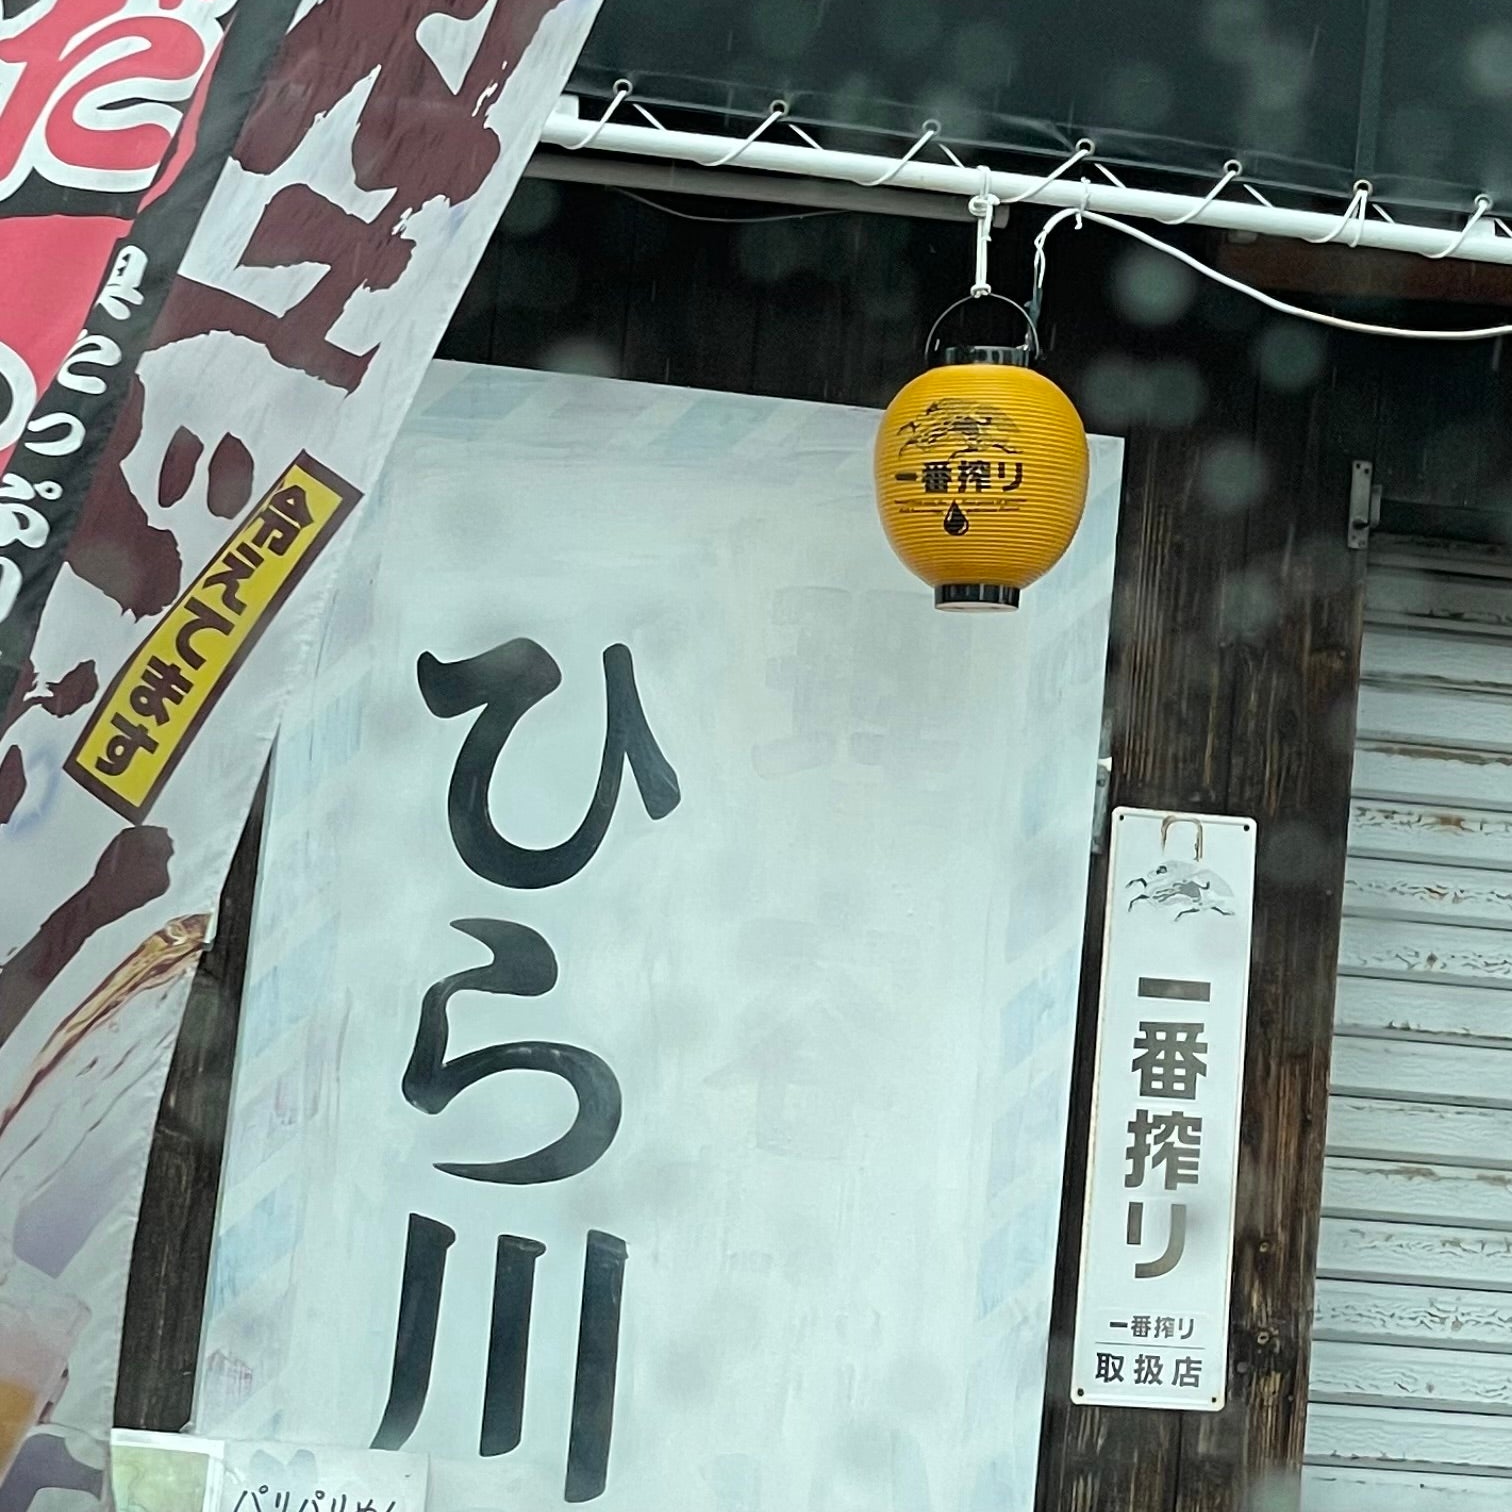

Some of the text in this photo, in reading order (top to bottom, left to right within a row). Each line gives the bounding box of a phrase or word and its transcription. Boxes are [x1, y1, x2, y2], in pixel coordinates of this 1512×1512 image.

[895, 460, 1023, 493] 一番搾り
[370, 637, 681, 1503] ひら川
[1124, 977, 1211, 1279] 一番搾り
[1109, 1315, 1195, 1340] 一番搾り
[1095, 1352, 1203, 1388] 取扱店
